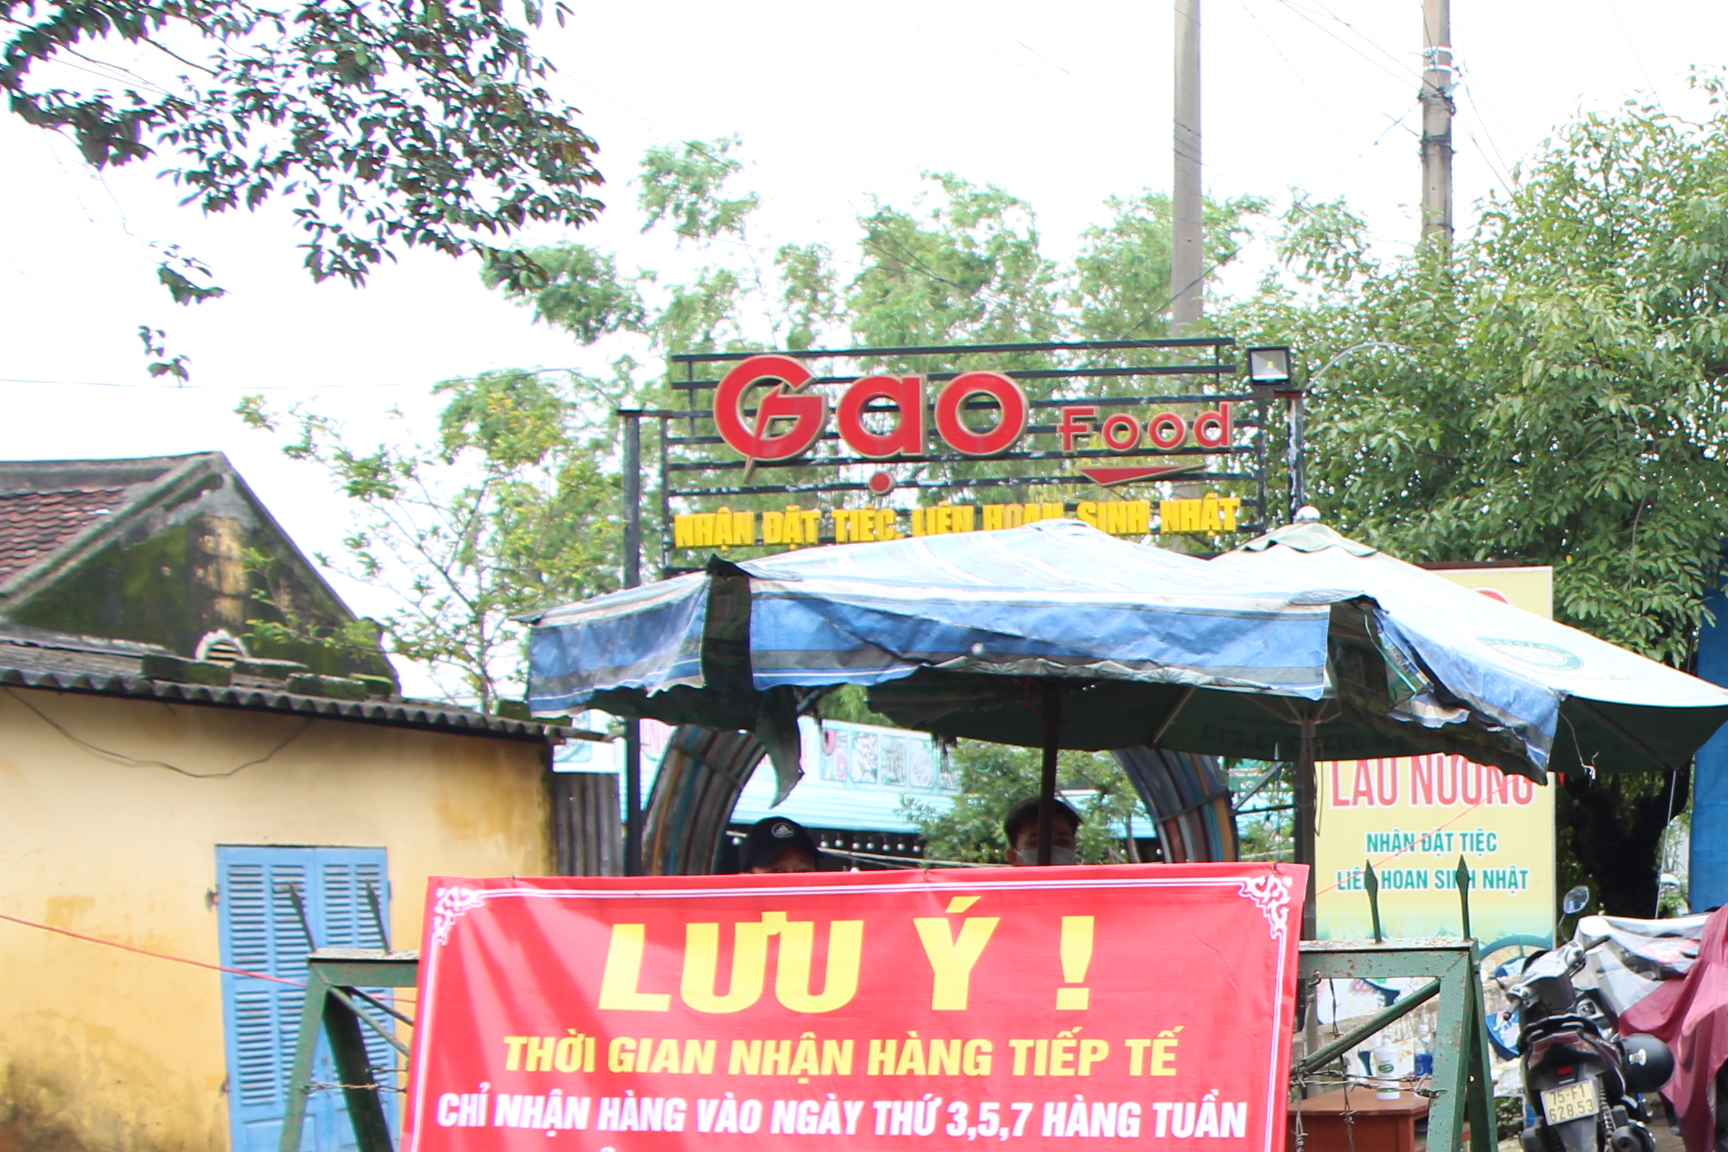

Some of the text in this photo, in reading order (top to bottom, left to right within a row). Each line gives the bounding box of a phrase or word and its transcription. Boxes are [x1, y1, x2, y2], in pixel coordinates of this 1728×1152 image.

[713, 353, 1028, 495] Gạo
[674, 506, 755, 551] NHẬN
[762, 504, 822, 550] ĐẶT
[1160, 492, 1240, 538] NHẬT
[1366, 828, 1498, 857] NHẬN ĐẶT TIỆC
[1337, 866, 1369, 890] LIÊ
[1381, 870, 1428, 889] HOAN
[1482, 865, 1529, 894] NHẬT
[599, 896, 1094, 1013] LƯU Ý !
[504, 1026, 1184, 1084] THỜI GIAN NHẬN HÀNG TIẾP TẾ
[437, 1082, 1247, 1141] CHỈ NHẬN HÀNG VÀO NGÀY THỨ 3,5,7 HÀNG TUẦN
[1549, 1099, 1594, 1121] 628.53
[1551, 1084, 1586, 1105] 75-F1
